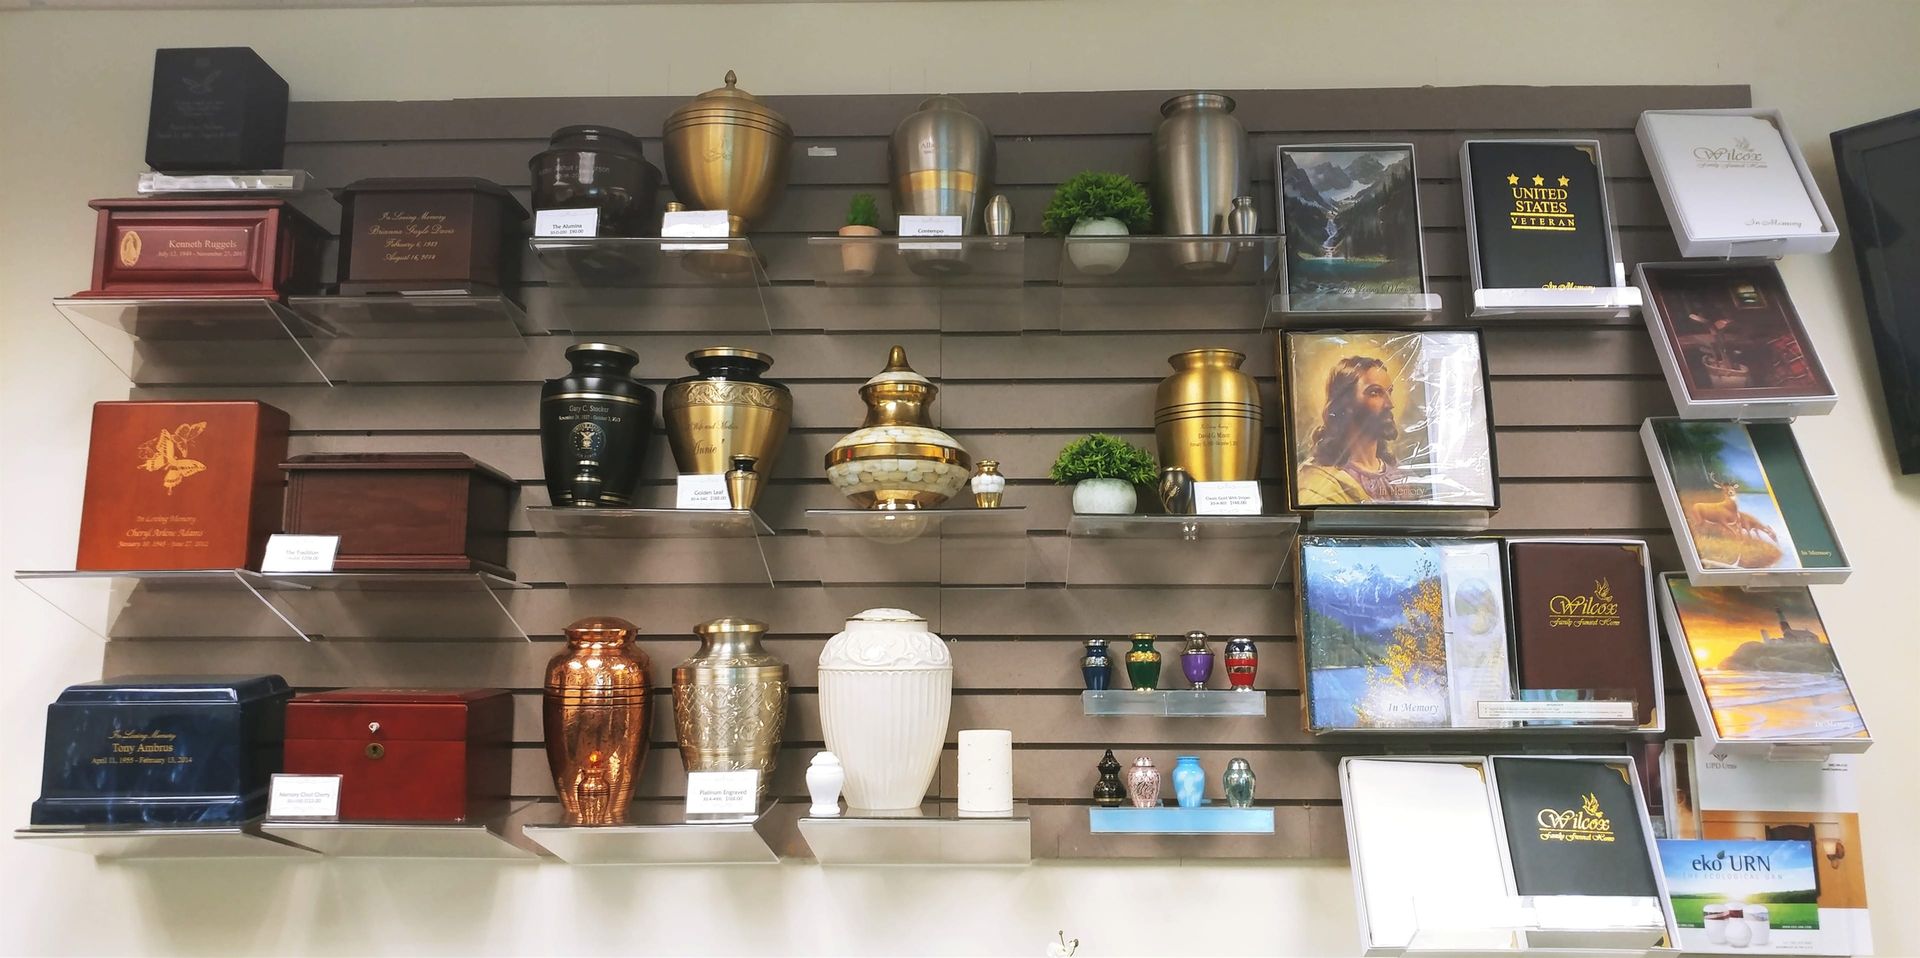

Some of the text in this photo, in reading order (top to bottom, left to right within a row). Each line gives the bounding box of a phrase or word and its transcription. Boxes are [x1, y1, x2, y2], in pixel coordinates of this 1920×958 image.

[1693, 147, 1763, 162] Wilcox
[1512, 187, 1568, 200] UNITED
[1515, 201, 1568, 213] STATES
[1511, 217, 1576, 227] VETERAN
[1743, 217, 1803, 228] In Memory
[168, 239, 238, 250] Kenneth Ruggels
[1549, 595, 1618, 615] Wilcox
[1388, 703, 1439, 714] In Memory
[112, 743, 174, 754] Tony Ambrus
[1537, 808, 1610, 831] Wilcox
[1692, 854, 1771, 872] eko URN
